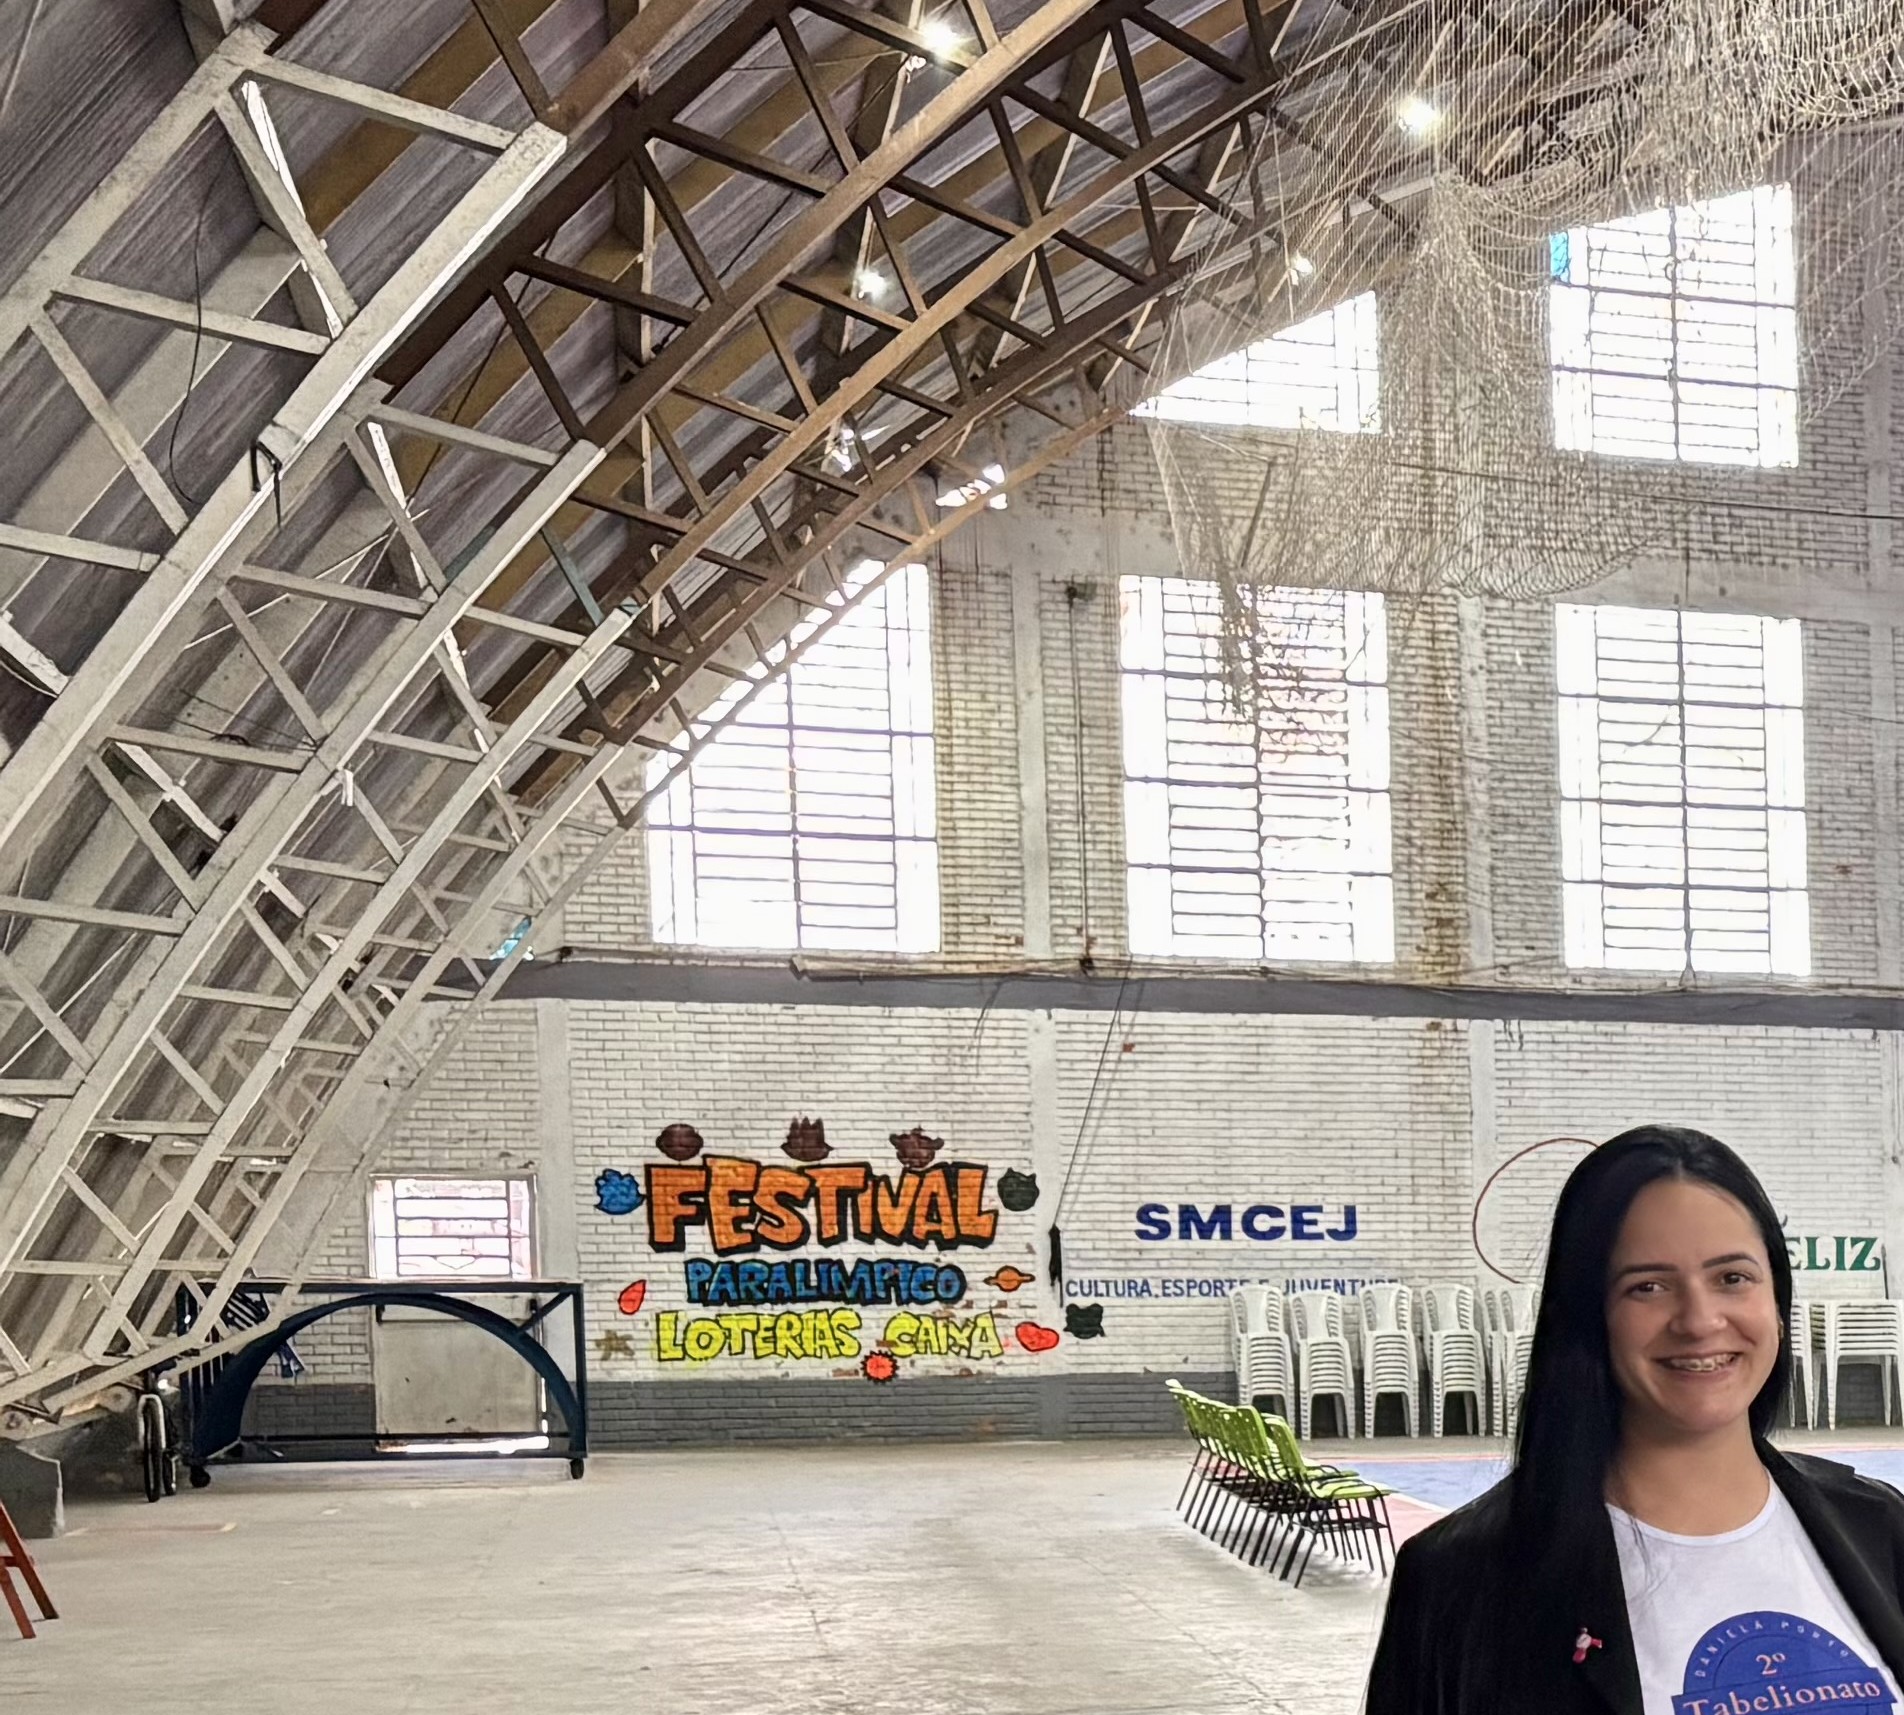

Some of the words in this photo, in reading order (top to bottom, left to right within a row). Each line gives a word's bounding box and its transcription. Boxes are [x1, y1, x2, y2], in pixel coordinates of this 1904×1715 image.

[644, 1154, 998, 1256] FESTIVAL
[1134, 1203, 1358, 1242] SMCEJ
[1784, 1236, 1881, 1271] ELIZ
[685, 1257, 967, 1306] PARALIMPICO
[656, 1309, 862, 1361] LOTERIAS
[883, 1310, 1004, 1360] CAIXA
